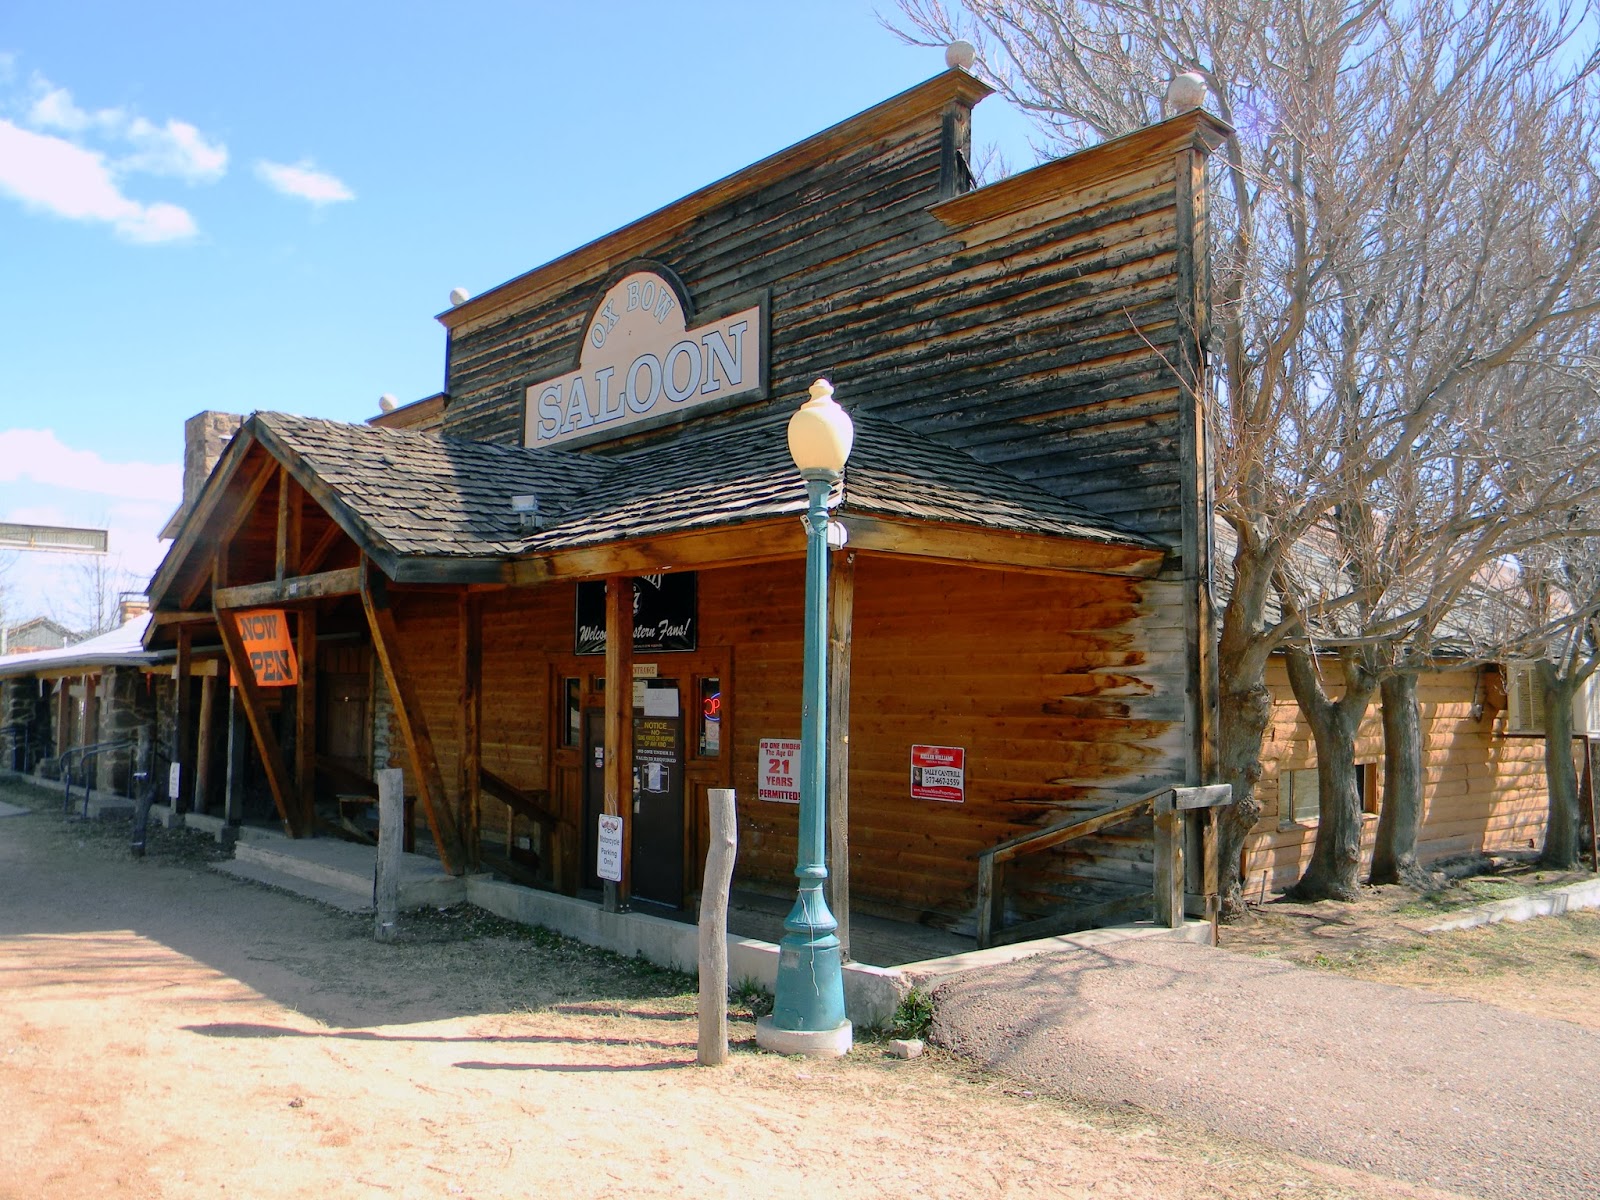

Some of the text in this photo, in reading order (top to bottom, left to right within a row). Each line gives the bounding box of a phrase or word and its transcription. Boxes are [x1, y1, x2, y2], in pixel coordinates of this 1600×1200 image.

[591, 280, 675, 349] OX BOW
[537, 321, 748, 441] SALOON
[241, 615, 277, 641] NOW
[580, 618, 691, 641] Welco stern Fans!
[250, 650, 293, 681] PEN
[644, 722, 667, 730] NOTICE
[770, 742, 780, 750] ONE
[776, 749, 785, 757] Age
[769, 758, 790, 774] 21
[924, 768, 937, 776] SALLY
[766, 776, 793, 787] YEARS
[760, 789, 801, 801] PERMITTED!
[600, 835, 620, 846] Motorcycle
[601, 847, 617, 859] Parking
[604, 857, 613, 867] Only
